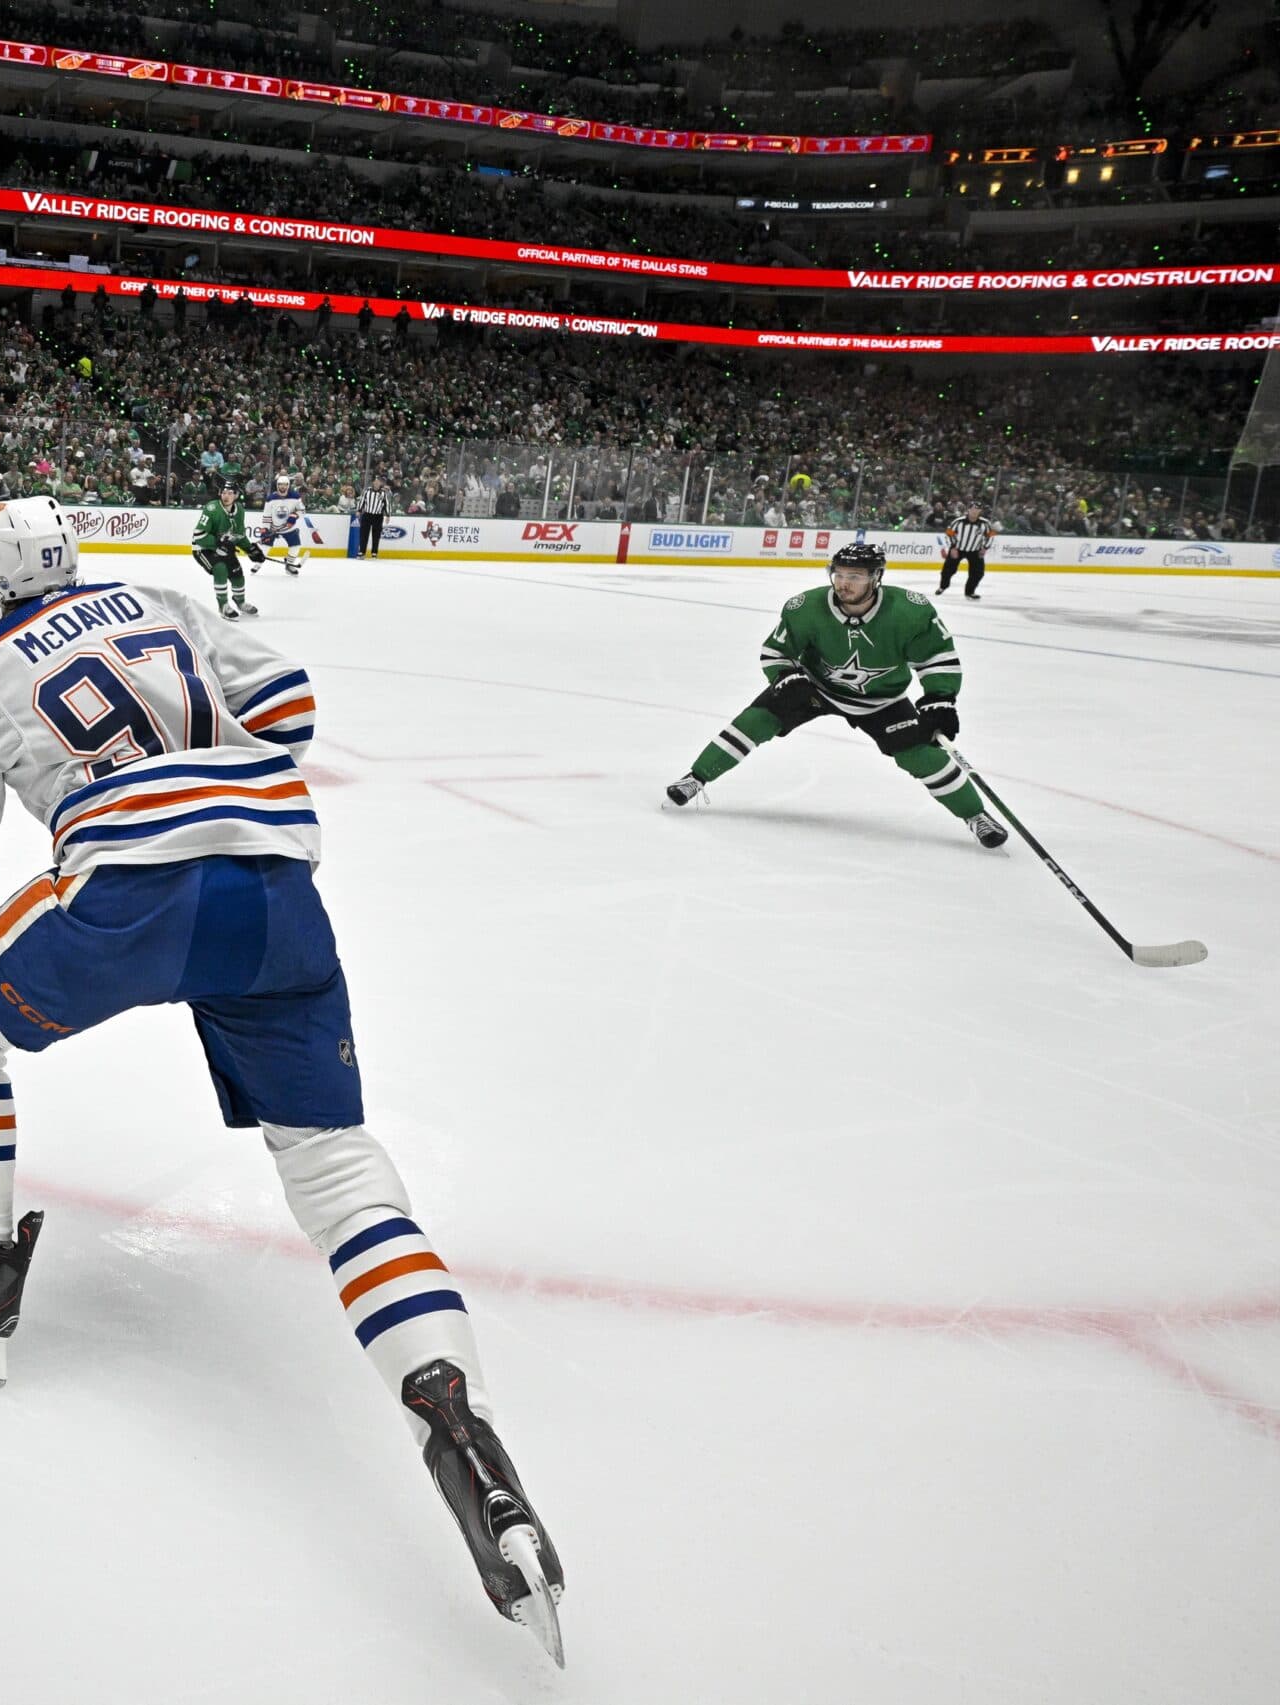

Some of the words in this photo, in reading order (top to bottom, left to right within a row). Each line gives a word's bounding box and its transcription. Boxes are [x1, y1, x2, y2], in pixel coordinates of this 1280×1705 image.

[22, 192, 94, 216] VALLEY
[97, 203, 149, 222] RIDGE
[153, 209, 230, 230] ROOFING
[234, 217, 246, 231] &
[249, 219, 374, 245] CONSTRUCTION
[518, 248, 560, 260] OFFICIAL
[562, 253, 605, 266] PARTNER
[607, 258, 620, 266] OF
[622, 258, 640, 269] THE
[641, 262, 677, 273] DALLAS
[679, 264, 708, 275] STARS
[847, 271, 913, 289] VALLEY
[916, 276, 973, 289] RIDGE
[978, 275, 1067, 289] ROOFING
[1072, 274, 1087, 287] &
[1093, 268, 1273, 286] CONSTRUCTION
[121, 281, 161, 294] OFFICL
[222, 290, 239, 299] THE
[241, 293, 275, 303] ALLAS
[277, 296, 305, 305] STARS
[421, 302, 469, 320] VALEY
[470, 310, 505, 324] RIDGE
[508, 313, 559, 329] ROOFING
[572, 319, 657, 336] CONSTRUCTION
[758, 335, 796, 345] OFFICIAL
[797, 337, 836, 346] PARTNER
[838, 338, 852, 347] OF
[853, 339, 870, 348] THE
[870, 340, 908, 349] DALLAS
[909, 340, 942, 349] STARS
[1091, 336, 1163, 351] VALLEY
[1164, 338, 1221, 350] RIDGE
[106, 516, 146, 537] Pepper
[121, 512, 136, 525] Dr
[447, 527, 468, 535] BEST
[471, 527, 480, 535] IN
[447, 535, 480, 543] TEXAS
[522, 523, 579, 541] DEX
[534, 541, 582, 552] imaging
[652, 533, 686, 547] BUD
[687, 534, 731, 548] LIGHT
[880, 542, 933, 555] American
[41, 546, 63, 568] 97
[1096, 545, 1146, 555] BOEING
[1210, 554, 1233, 566] Bank
[12, 591, 145, 665] McDAVID
[32, 626, 219, 784] 97
[884, 718, 919, 734] CCM
[0, 982, 77, 1033] CCM
[414, 1368, 441, 1386] CCM
